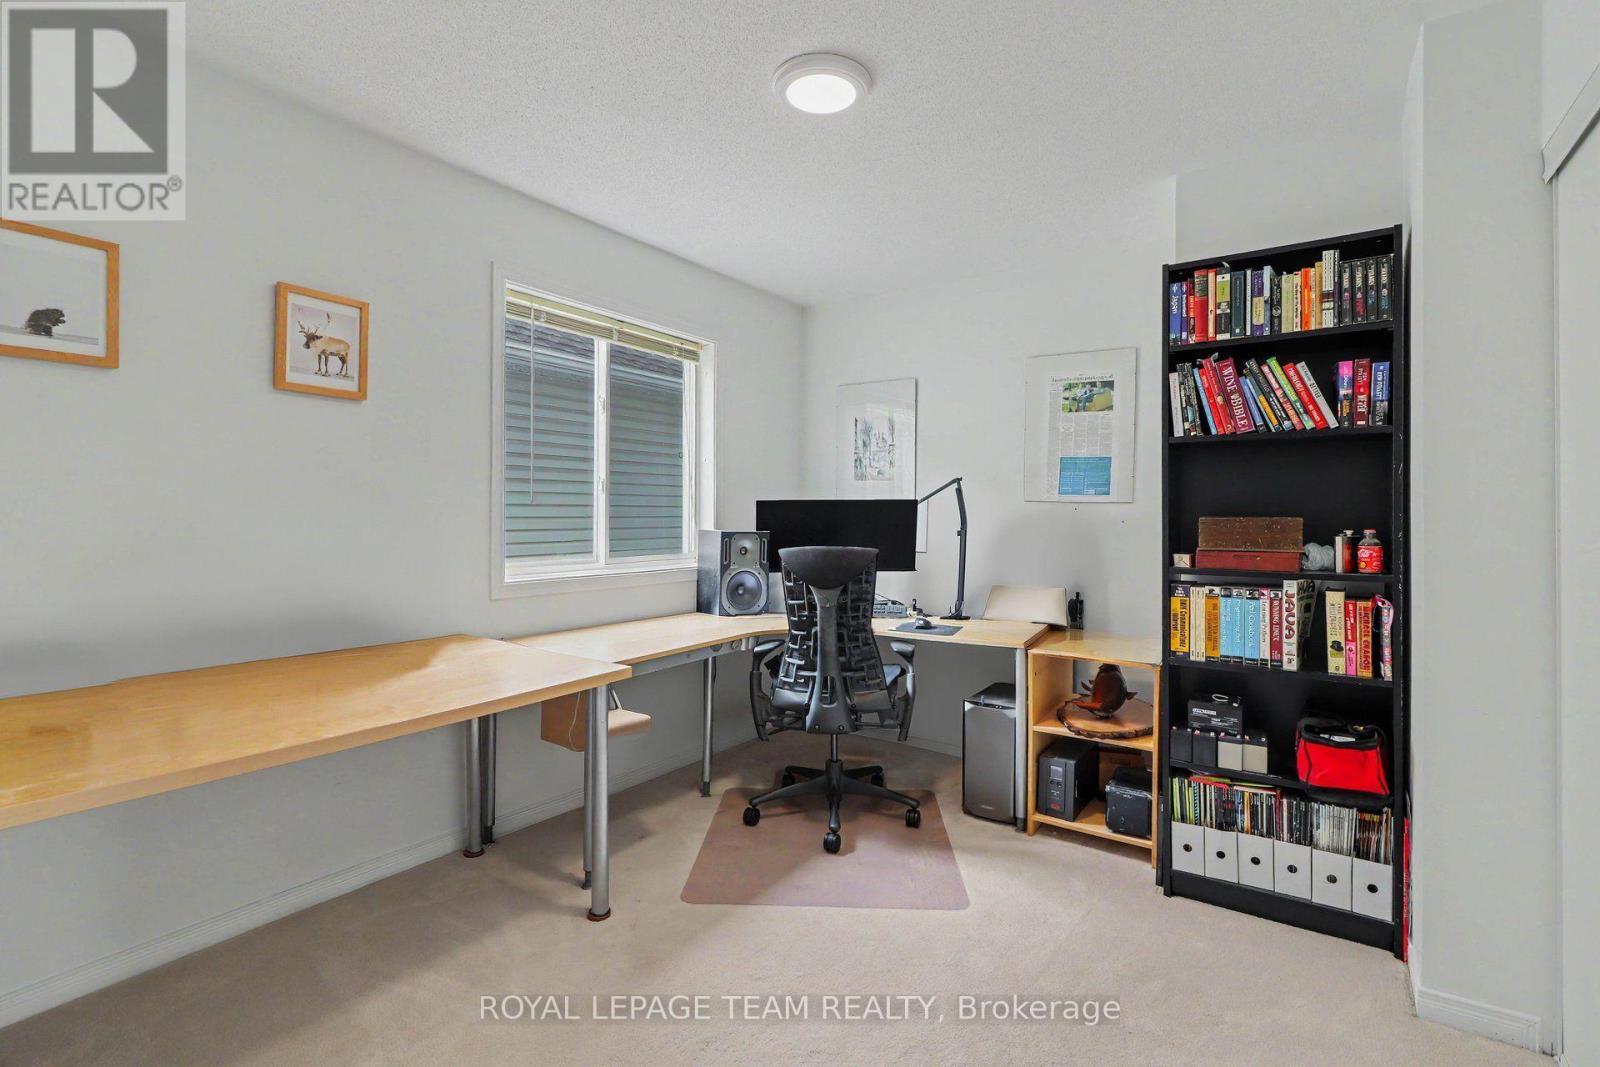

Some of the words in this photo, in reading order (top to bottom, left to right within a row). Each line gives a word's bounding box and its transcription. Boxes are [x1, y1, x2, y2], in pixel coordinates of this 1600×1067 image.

[1171, 296, 1180, 314] Japan
[1222, 366, 1237, 392] WINE
[1230, 398, 1248, 428] BIBLE
[1285, 590, 1296, 640] JAVA
